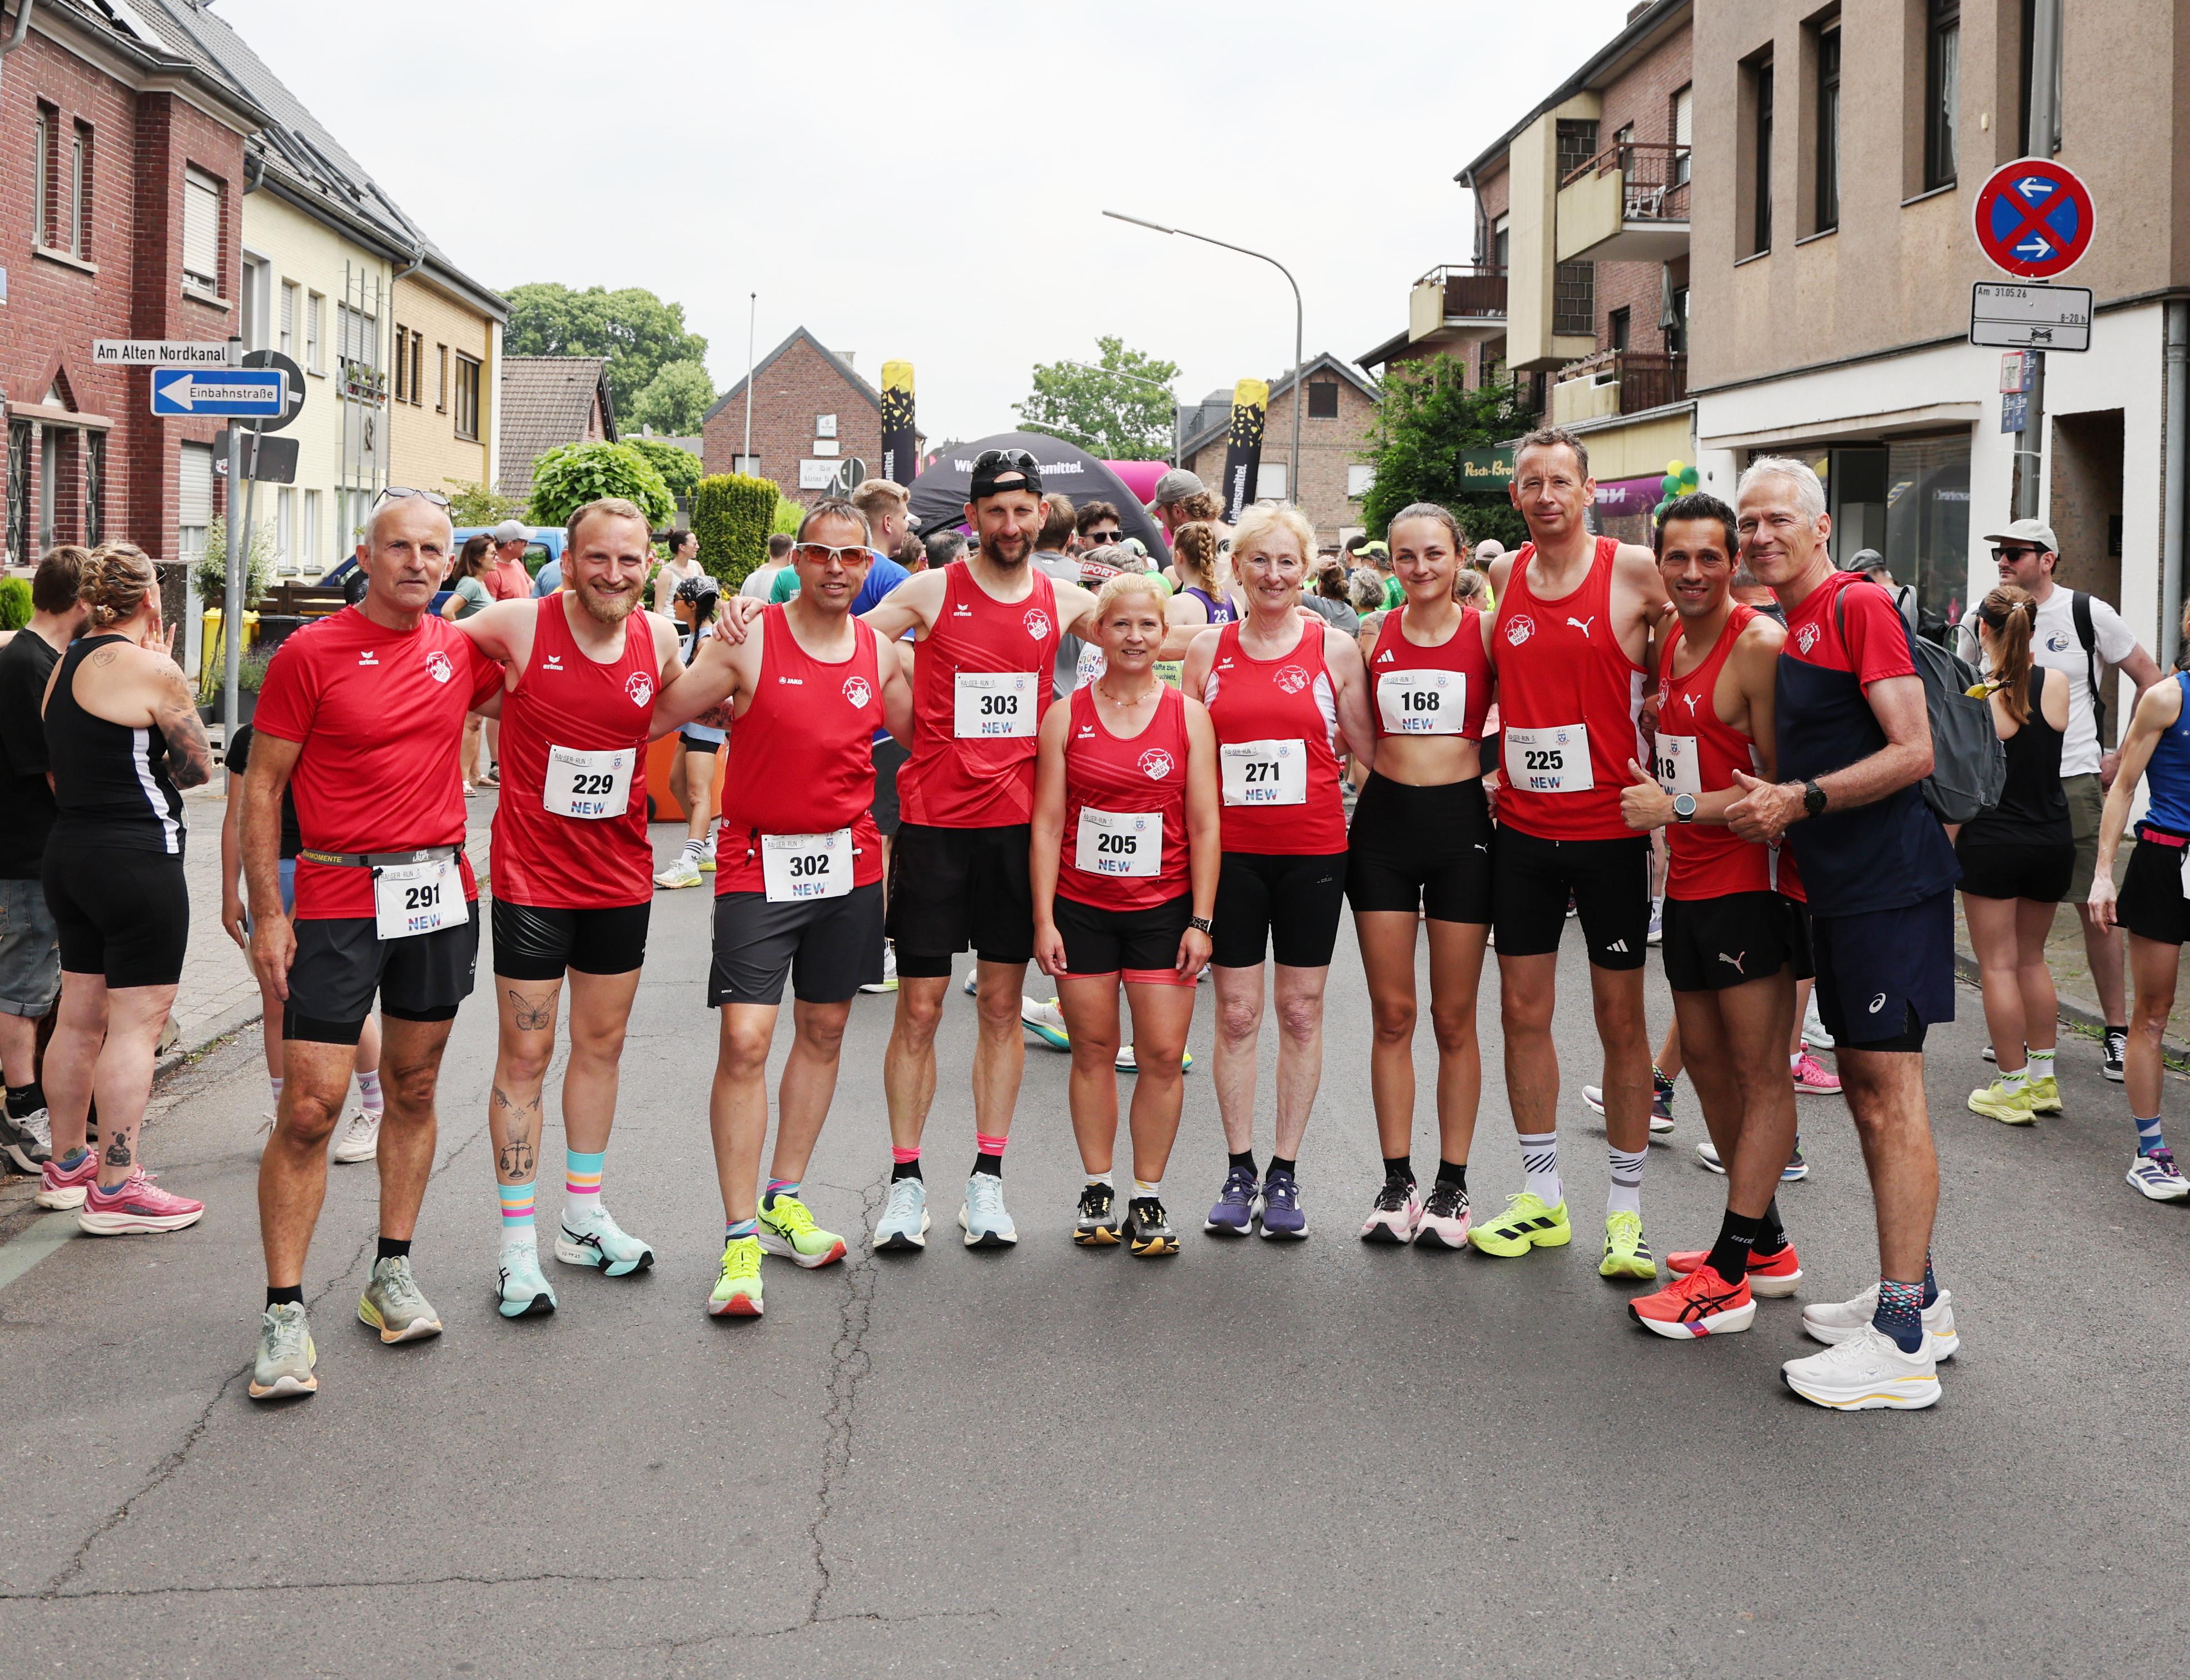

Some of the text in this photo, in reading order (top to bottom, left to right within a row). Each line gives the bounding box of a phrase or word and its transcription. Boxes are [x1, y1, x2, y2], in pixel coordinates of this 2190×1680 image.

[1978, 287, 2027, 298] Am 31.05.26
[2060, 313, 2086, 323] 8-20 h
[97, 344, 226, 361] Am Alten Nordkanal
[190, 387, 274, 400] Einbahnstraße
[1039, 461, 1084, 474] smittel.
[1464, 460, 1513, 478] Pesch-Bro
[1082, 563, 1118, 578] SPORT
[1214, 609, 1229, 623] 23
[980, 695, 1017, 715] 303
[1401, 692, 1439, 711] 168
[1147, 758, 1163, 769] TuS
[1153, 763, 1166, 773] OEDT
[1525, 750, 1563, 770] 225
[1657, 757, 1676, 779] 18
[1155, 768, 1168, 778] 1884
[1245, 762, 1279, 782] 271
[572, 774, 613, 795] 229
[1098, 833, 1137, 854] 205
[789, 854, 830, 877] 302
[405, 882, 440, 910] 291
